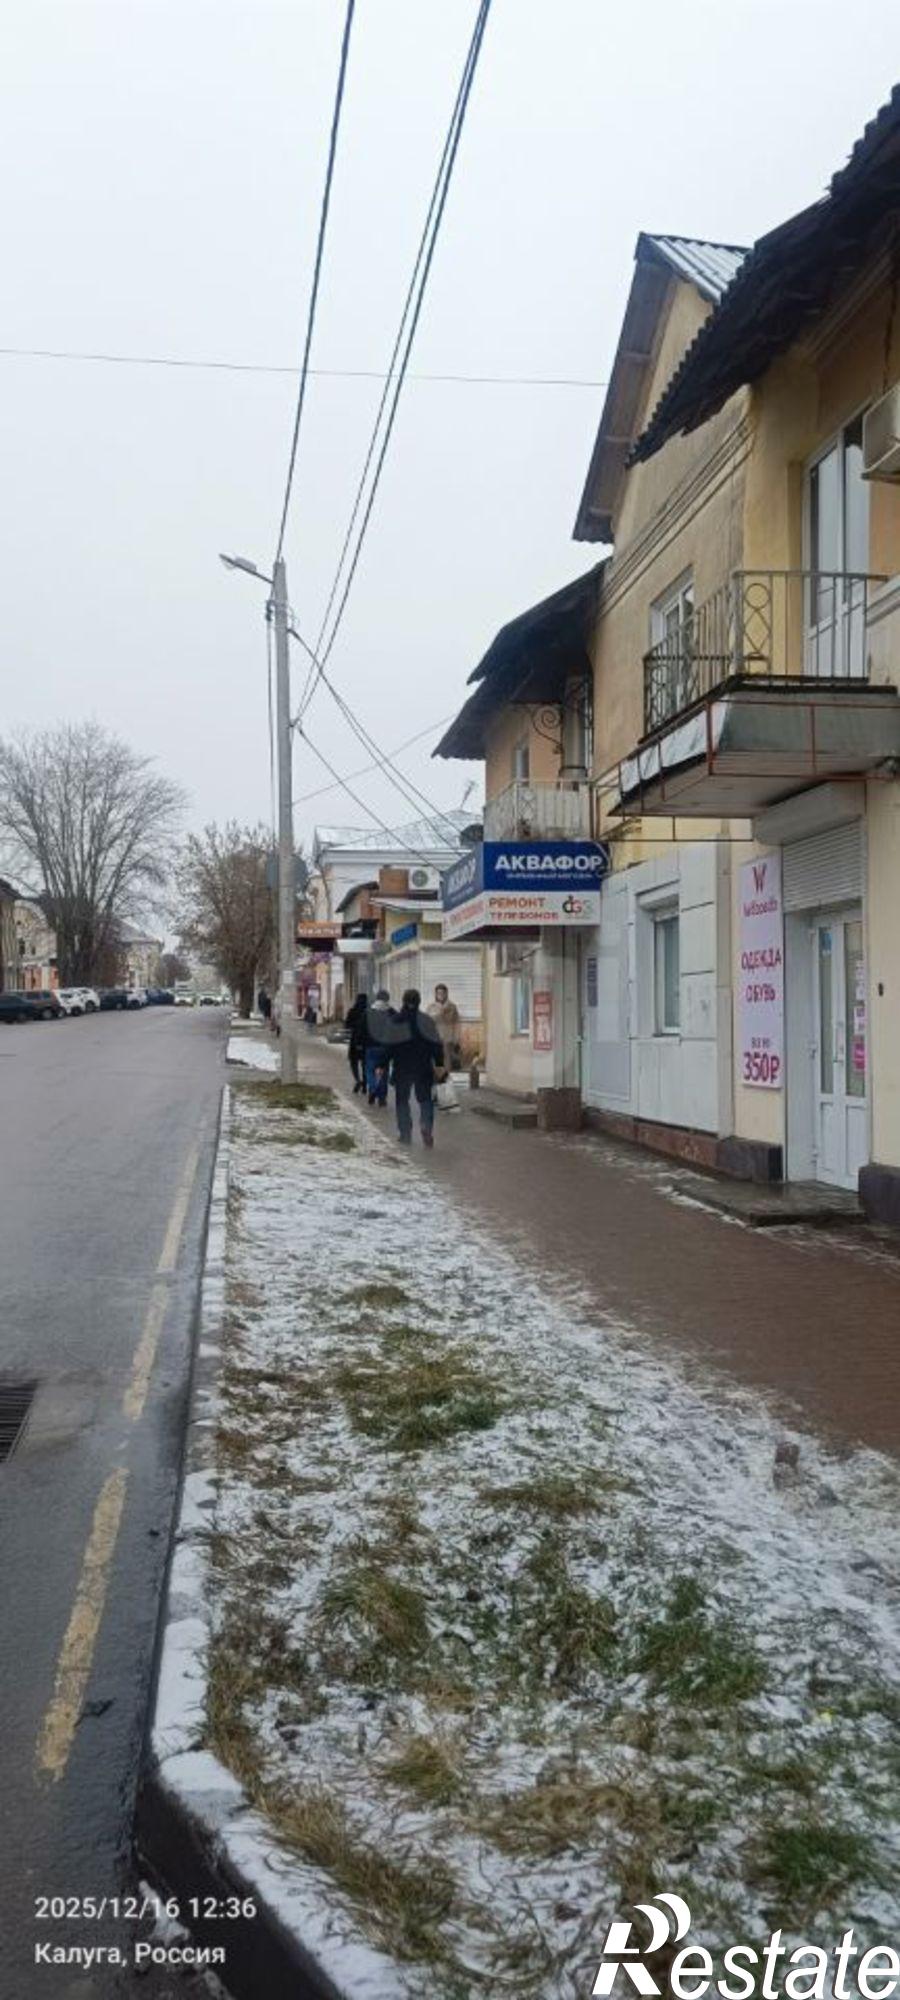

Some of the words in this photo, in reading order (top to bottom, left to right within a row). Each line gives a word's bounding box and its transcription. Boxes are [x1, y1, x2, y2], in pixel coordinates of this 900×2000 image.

[495, 855, 603, 871] АКВАФОР
[488, 897, 546, 908] РЕМОНТ
[489, 911, 560, 921] ТЕЛЕФОНОВ
[741, 947, 782, 974] ОДЕЖДА
[745, 983, 776, 1003] ОБУВЬ
